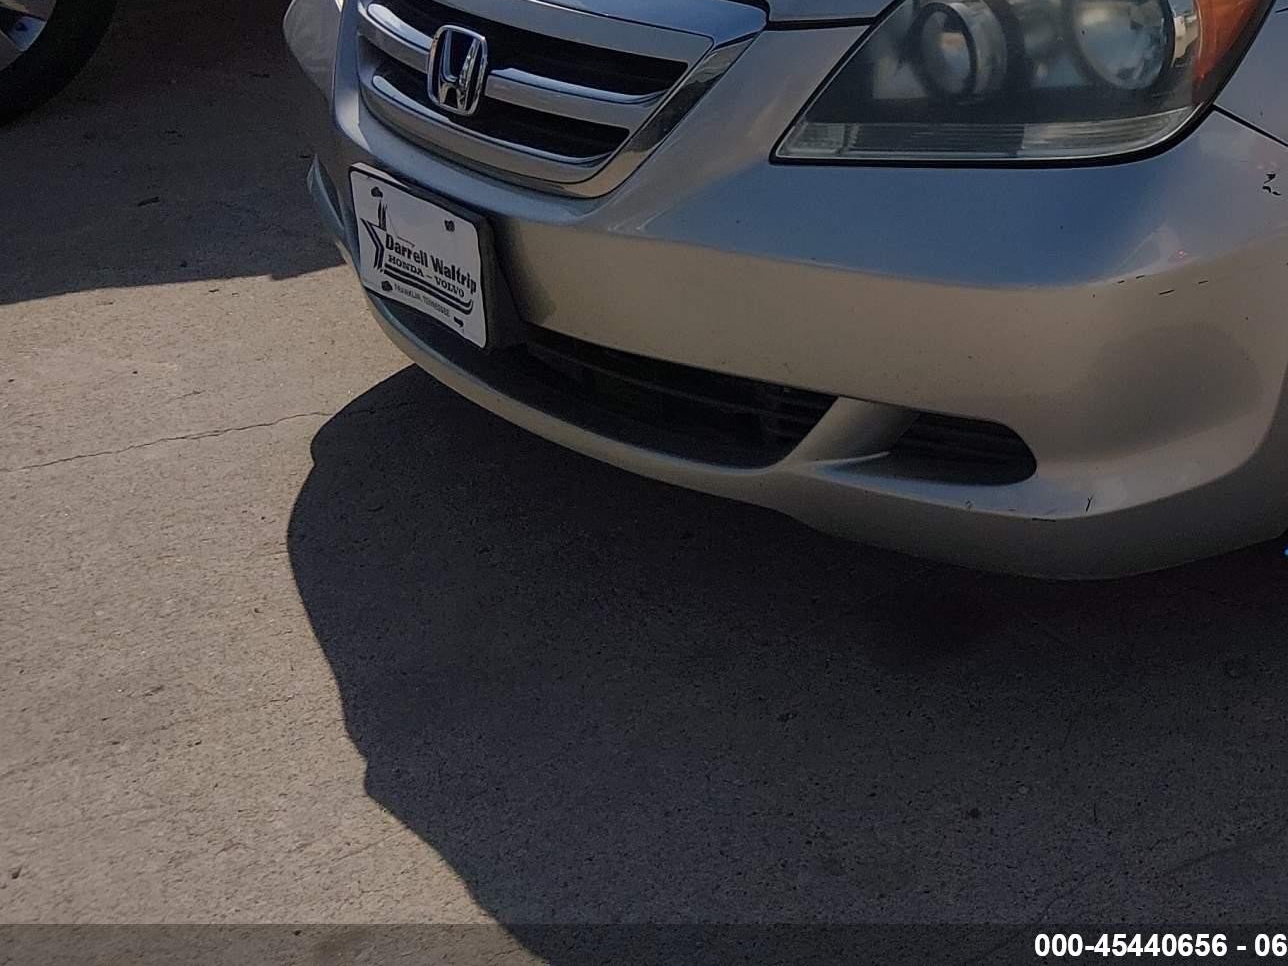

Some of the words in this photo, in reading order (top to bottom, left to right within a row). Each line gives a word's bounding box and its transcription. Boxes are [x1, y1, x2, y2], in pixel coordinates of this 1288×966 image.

[386, 234, 428, 268] Darrell
[430, 255, 477, 294] Waltrip
[388, 254, 424, 277] HONDA
[434, 275, 464, 298] VOLVO
